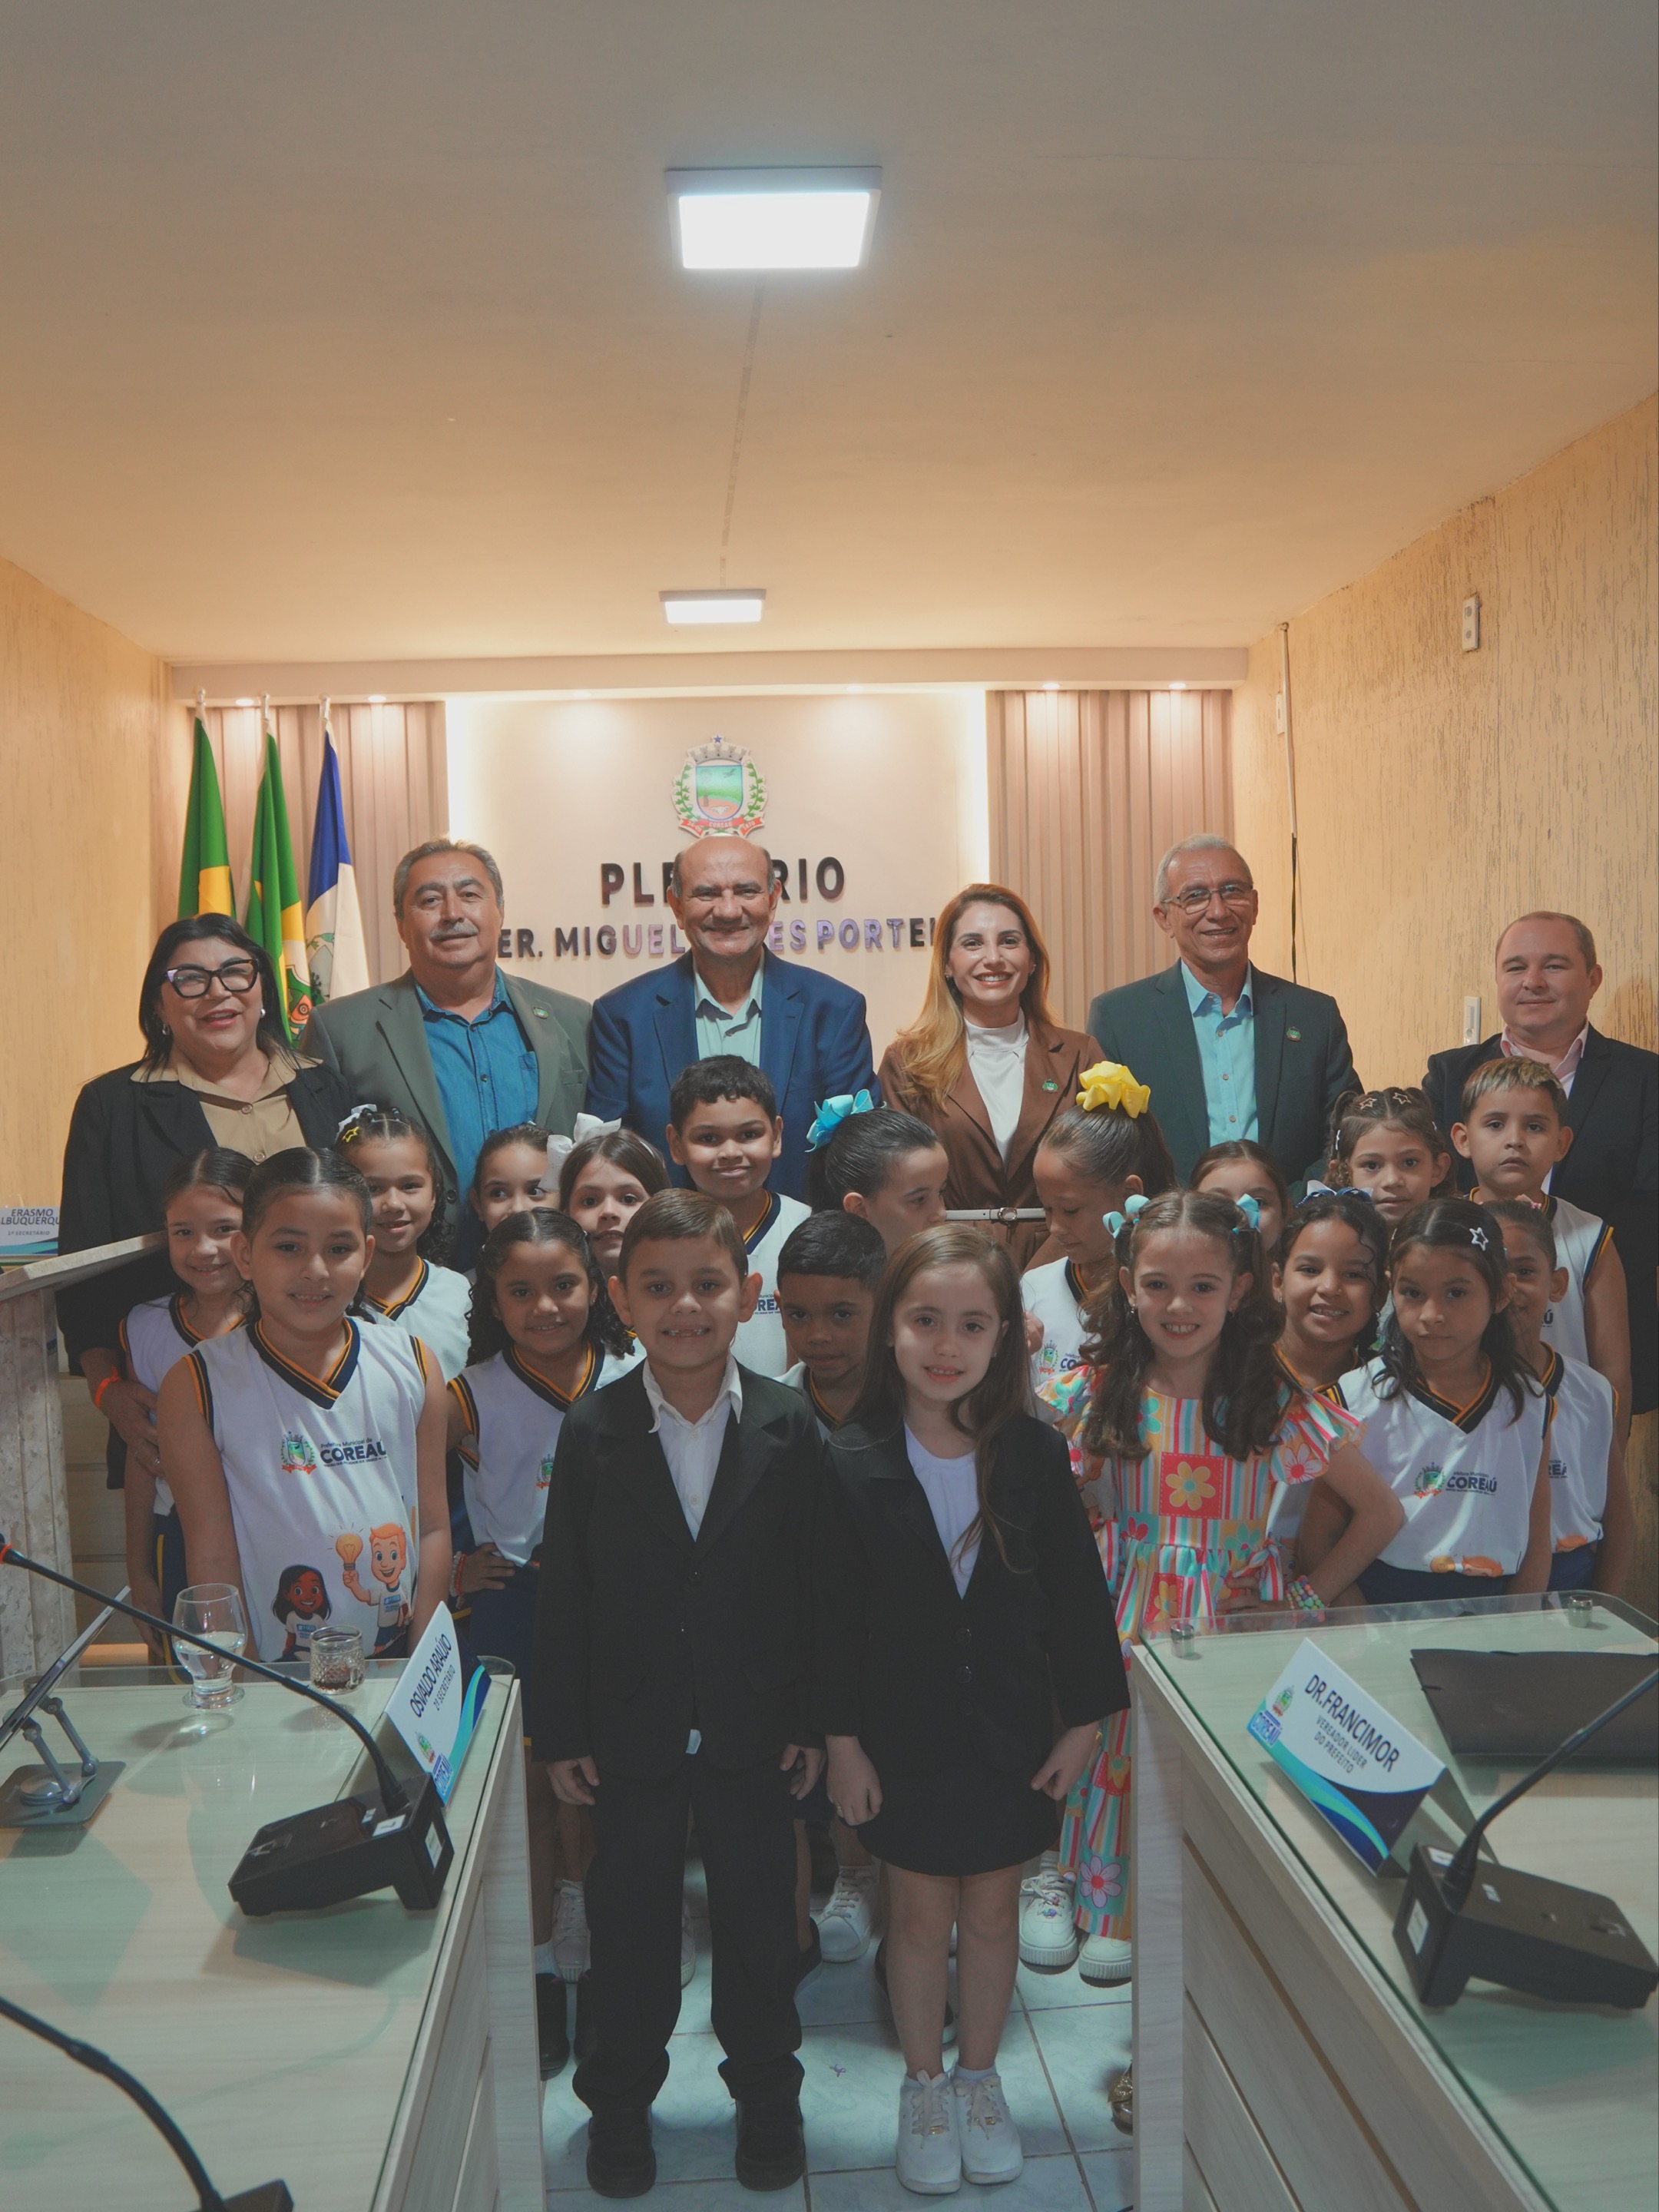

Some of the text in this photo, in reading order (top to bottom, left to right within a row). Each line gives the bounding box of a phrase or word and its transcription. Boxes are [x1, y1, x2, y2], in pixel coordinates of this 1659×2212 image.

[601, 856, 845, 906] PLRIO
[498, 928, 543, 959] ER.
[555, 924, 686, 958] MIGUEL
[1, 1216, 61, 1226] LBUQUERQU
[11, 1208, 54, 1217] ERASMO
[1447, 1476, 1497, 1493] COREAÚ
[410, 1634, 452, 1718] OSVALDO ARAÚJO
[437, 1664, 455, 1704] SECRETÁRIO
[1316, 1715, 1349, 1750] VEREADOR
[1313, 1731, 1354, 1773] DO PREFEITO
